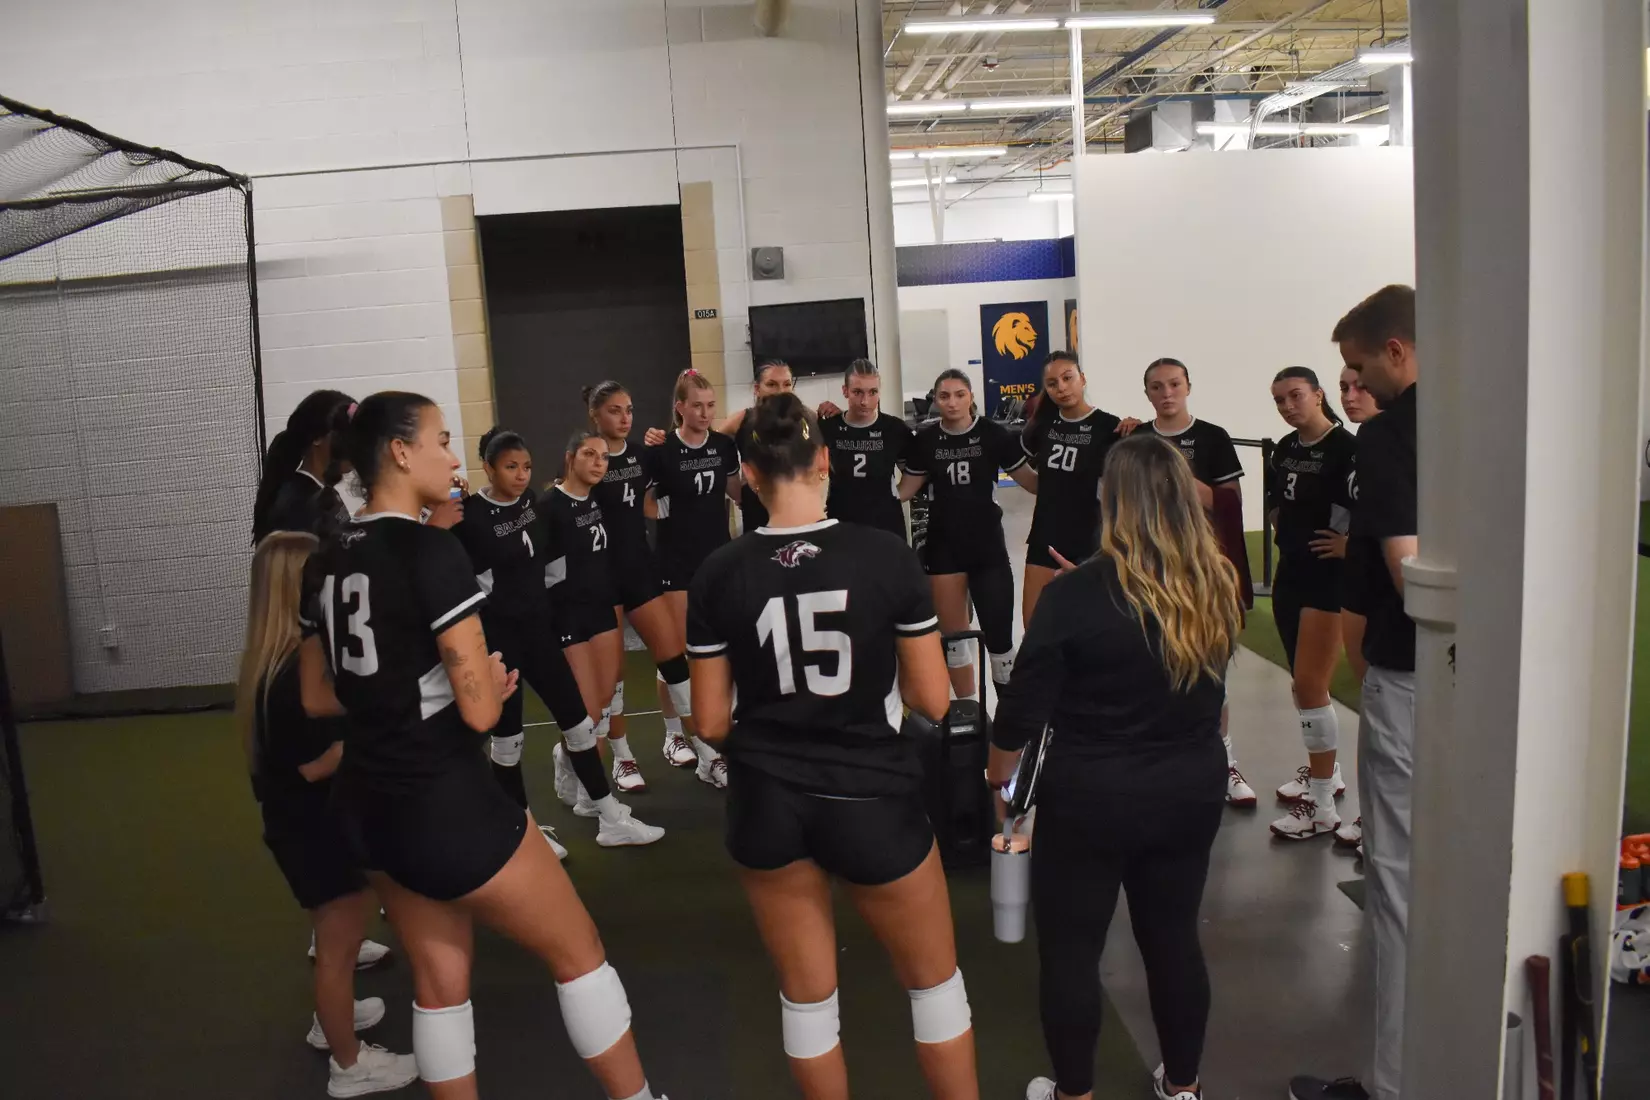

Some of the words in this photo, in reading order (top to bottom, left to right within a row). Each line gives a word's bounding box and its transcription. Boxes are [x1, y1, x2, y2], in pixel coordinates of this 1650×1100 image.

[697, 310, 715, 318] 015A
[1000, 383, 1035, 394] MEN'S
[836, 440, 884, 451] SALUKIS
[1048, 429, 1092, 446] SALUKIS
[680, 456, 722, 471] SALUKIS
[853, 453, 867, 477] 2
[935, 446, 982, 460] SALUKIS
[1047, 444, 1079, 472] 20
[694, 470, 715, 495] 17
[946, 461, 971, 485] 18
[622, 482, 636, 507] 4
[1283, 472, 1298, 501] 3
[493, 507, 537, 537] SALUKIS
[521, 530, 535, 557] 1
[589, 523, 608, 552] 21
[319, 572, 379, 676] 13
[756, 589, 852, 696] 15
